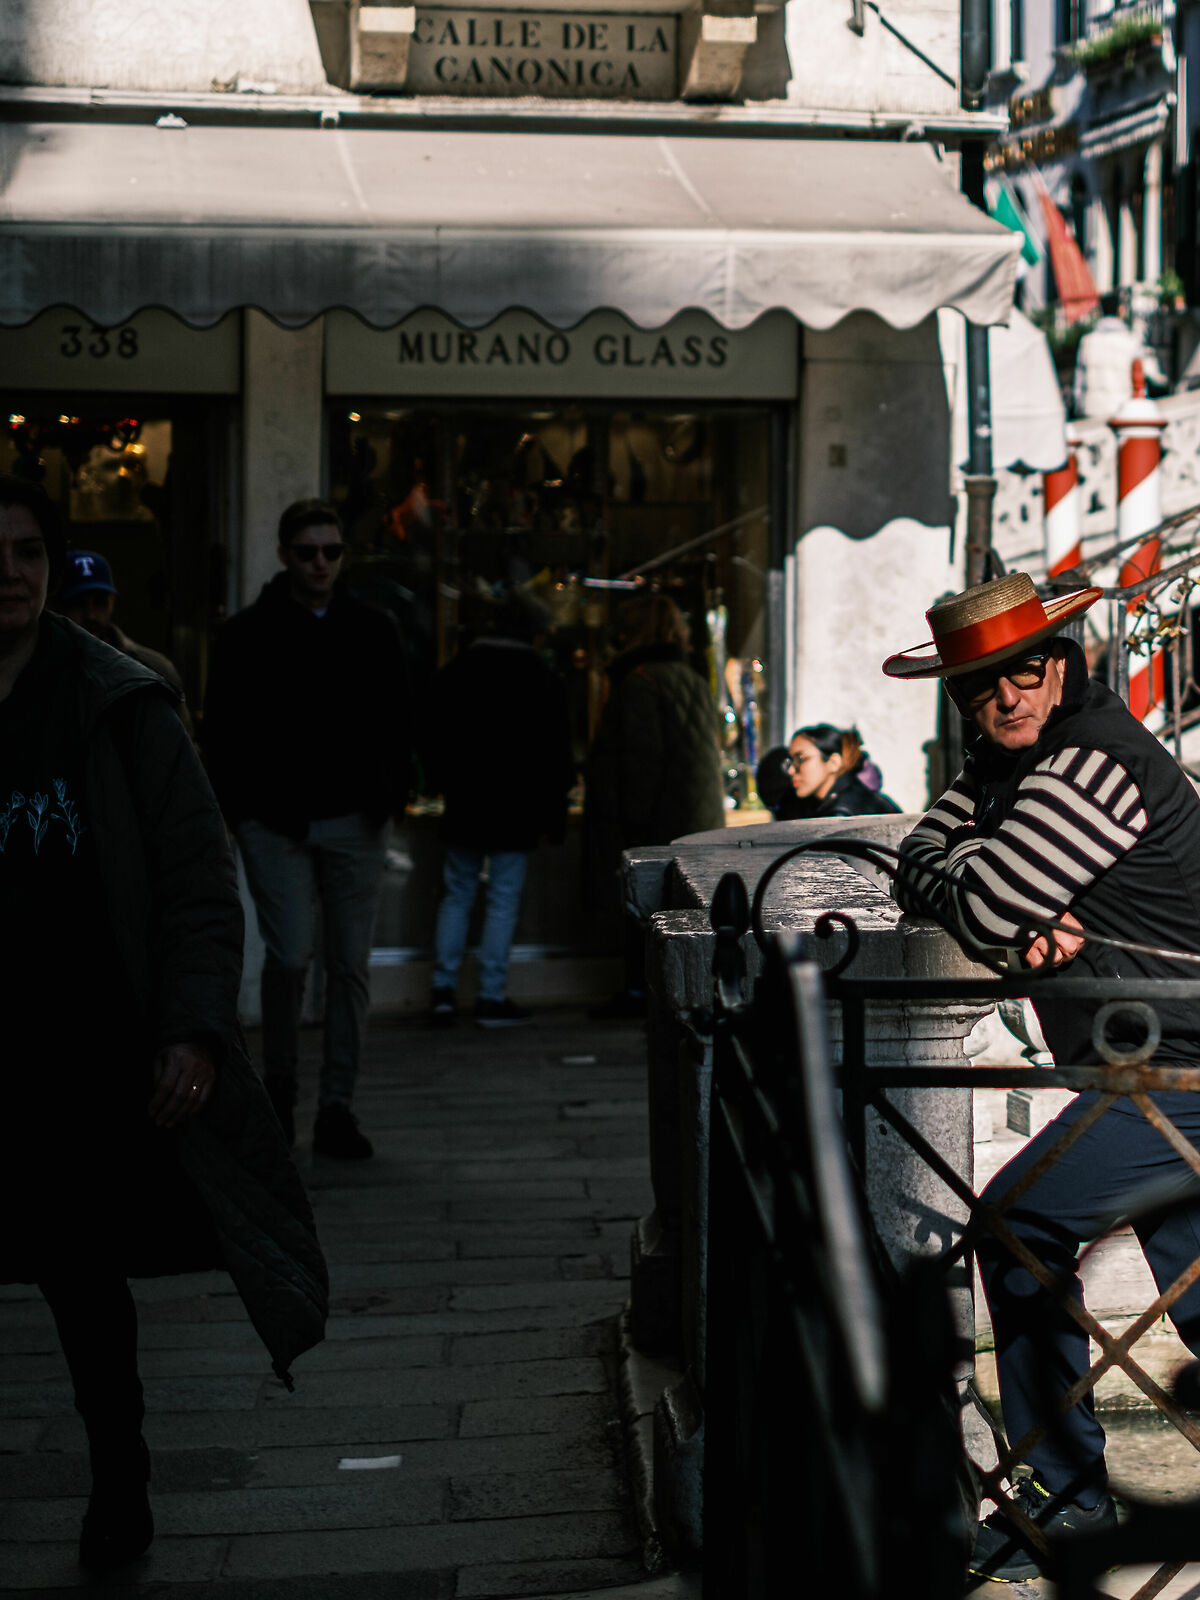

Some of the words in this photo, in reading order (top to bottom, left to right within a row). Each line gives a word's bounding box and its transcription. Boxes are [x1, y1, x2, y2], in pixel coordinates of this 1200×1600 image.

[411, 17, 541, 48] CALLE
[561, 22, 609, 50] DE
[626, 25, 670, 53] LA
[434, 56, 641, 89] CANONICA
[60, 326, 138, 359] 338
[398, 331, 571, 365] MURANO
[593, 334, 729, 367] GLASS
[74, 557, 95, 576] T
